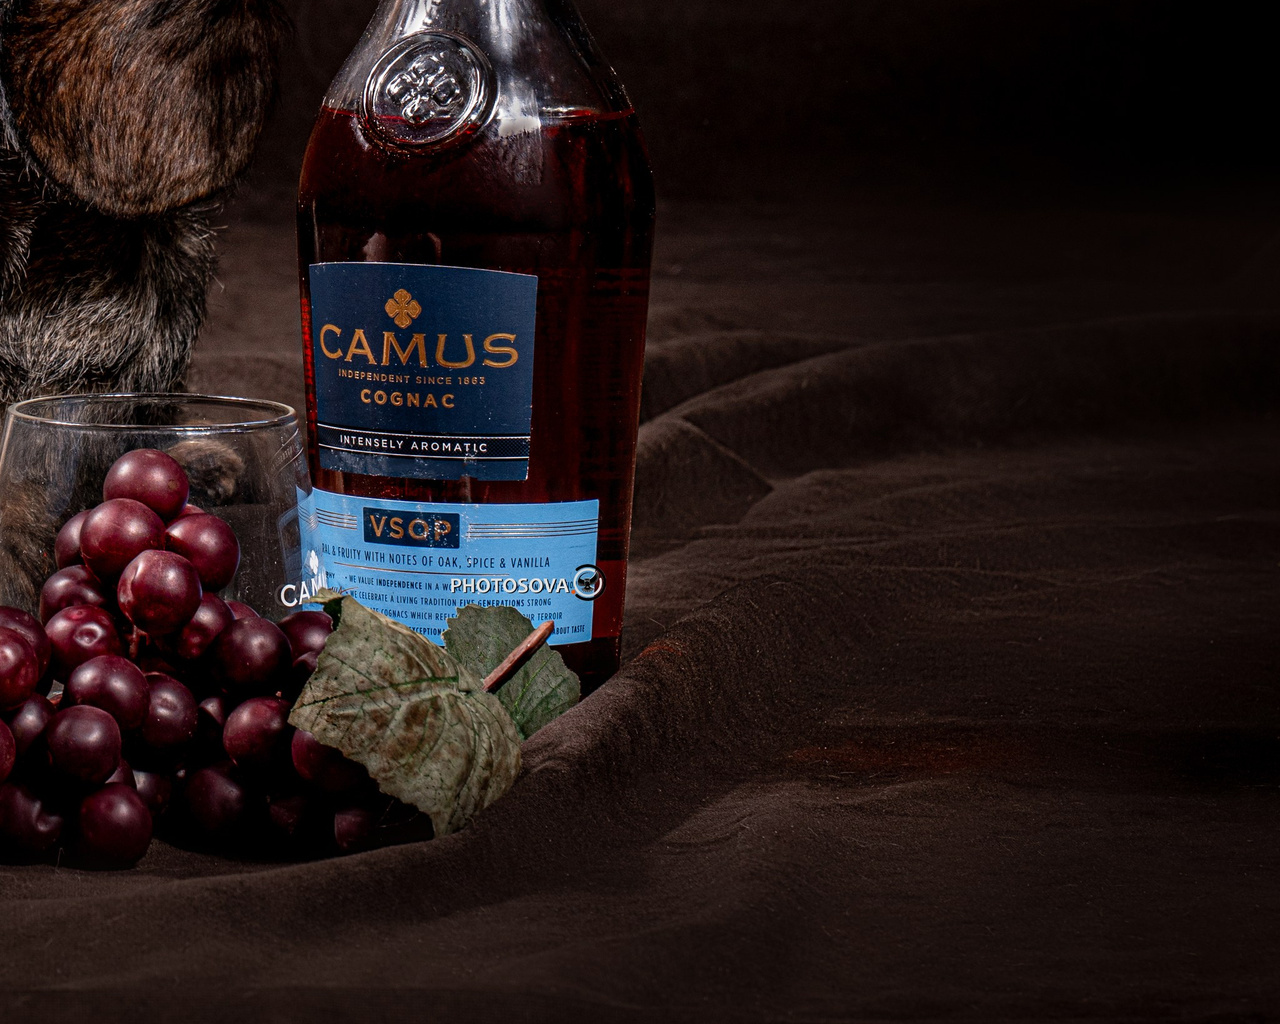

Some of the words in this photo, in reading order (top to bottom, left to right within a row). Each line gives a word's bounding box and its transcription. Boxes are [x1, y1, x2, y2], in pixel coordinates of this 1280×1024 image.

[319, 324, 519, 368] CAMUS
[338, 368, 410, 384] INDEPENDENT
[415, 376, 452, 385] SINCE
[458, 376, 486, 385] 1863
[360, 388, 455, 409] COGNAC
[339, 434, 404, 449] INTENSELY
[410, 441, 488, 453] AROMATIC
[369, 514, 453, 542] VSOP
[332, 545, 336, 556] &
[337, 546, 362, 560] FRUITY
[364, 550, 385, 563] WITH
[389, 553, 418, 566] NOTES
[421, 555, 434, 567] OF
[437, 556, 462, 569] OAK,
[466, 557, 495, 569] SPICE
[499, 557, 506, 569] &
[510, 556, 550, 568] VANILLA
[357, 576, 374, 586] VALUE
[376, 578, 423, 590] INDEPENDENCE
[424, 582, 433, 591] IN
[434, 582, 440, 591] A
[358, 591, 388, 603] CELEBRATE
[389, 594, 395, 603] A
[396, 596, 418, 605] LIVING
[420, 597, 457, 607] TRADITION
[478, 599, 525, 608] GENERATIONS
[527, 598, 552, 607] STRONG
[380, 608, 408, 619] COGNACS
[410, 611, 433, 621] WHICH
[537, 612, 563, 621] TERROIR
[571, 624, 586, 634] TASTE
